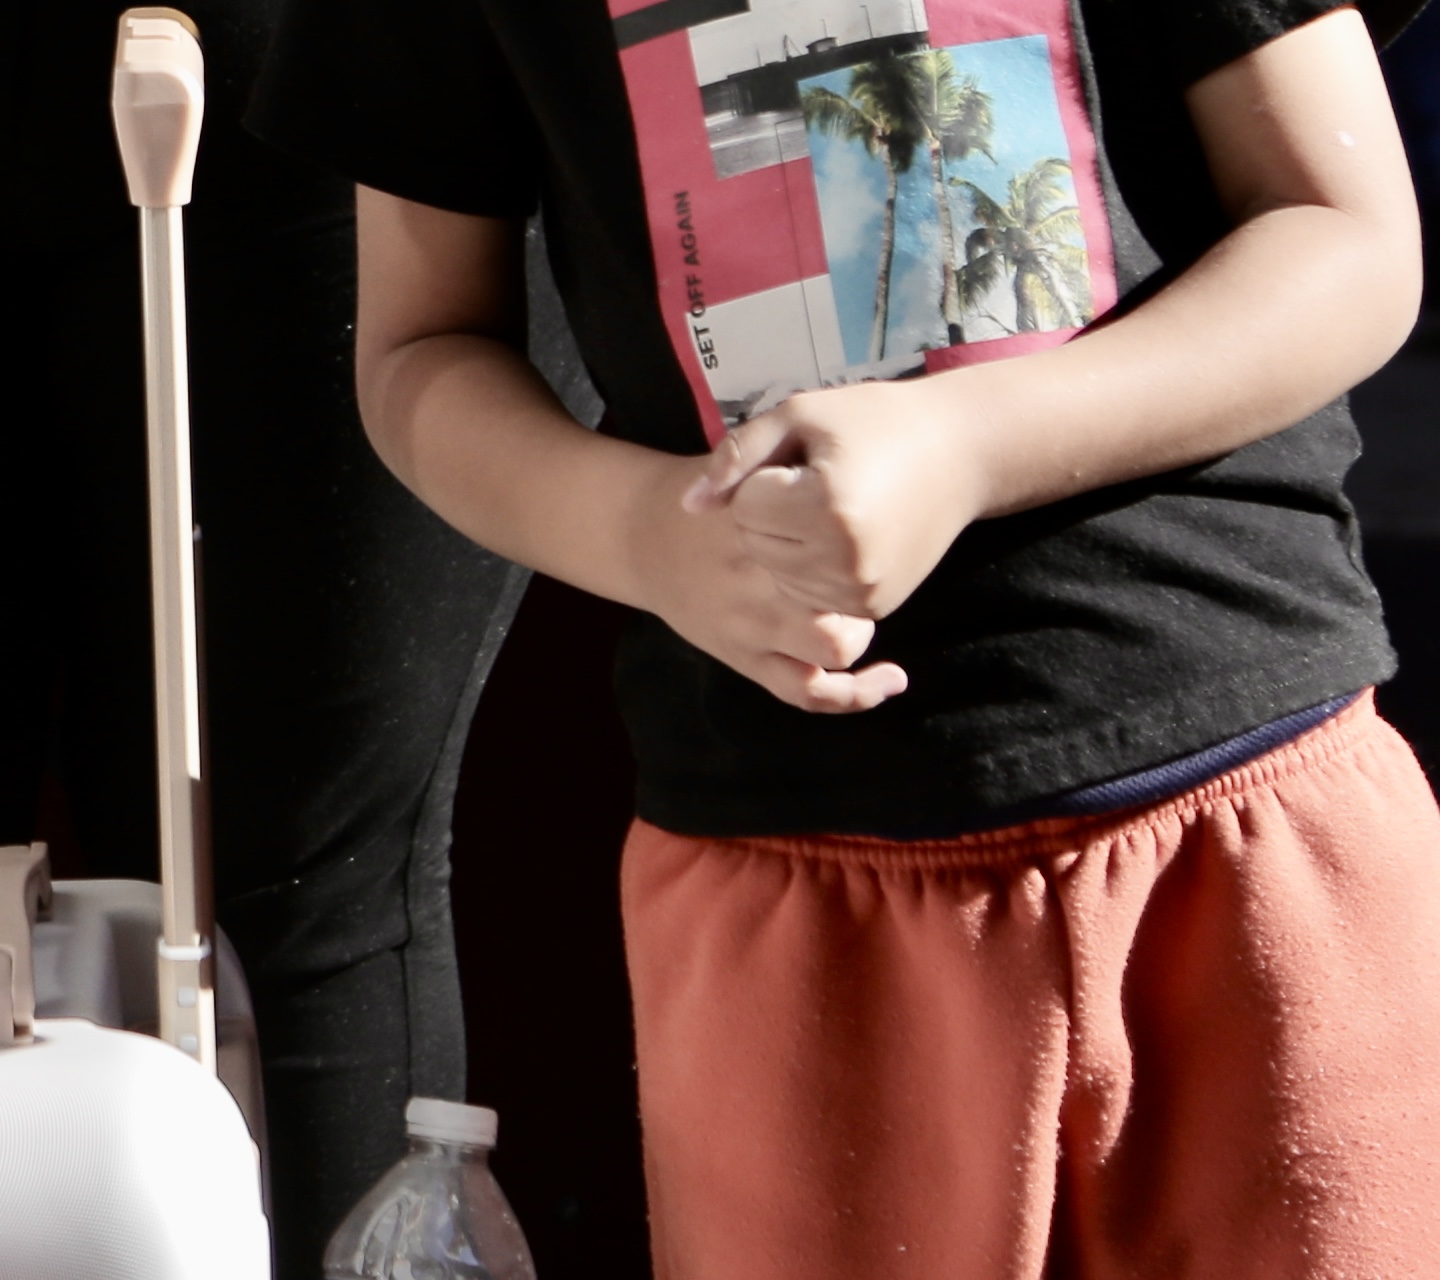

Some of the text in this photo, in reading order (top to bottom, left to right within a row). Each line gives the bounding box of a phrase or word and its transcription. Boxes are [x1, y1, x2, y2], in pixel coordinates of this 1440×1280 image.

[674, 189, 719, 370] SET OFF AGAIN
